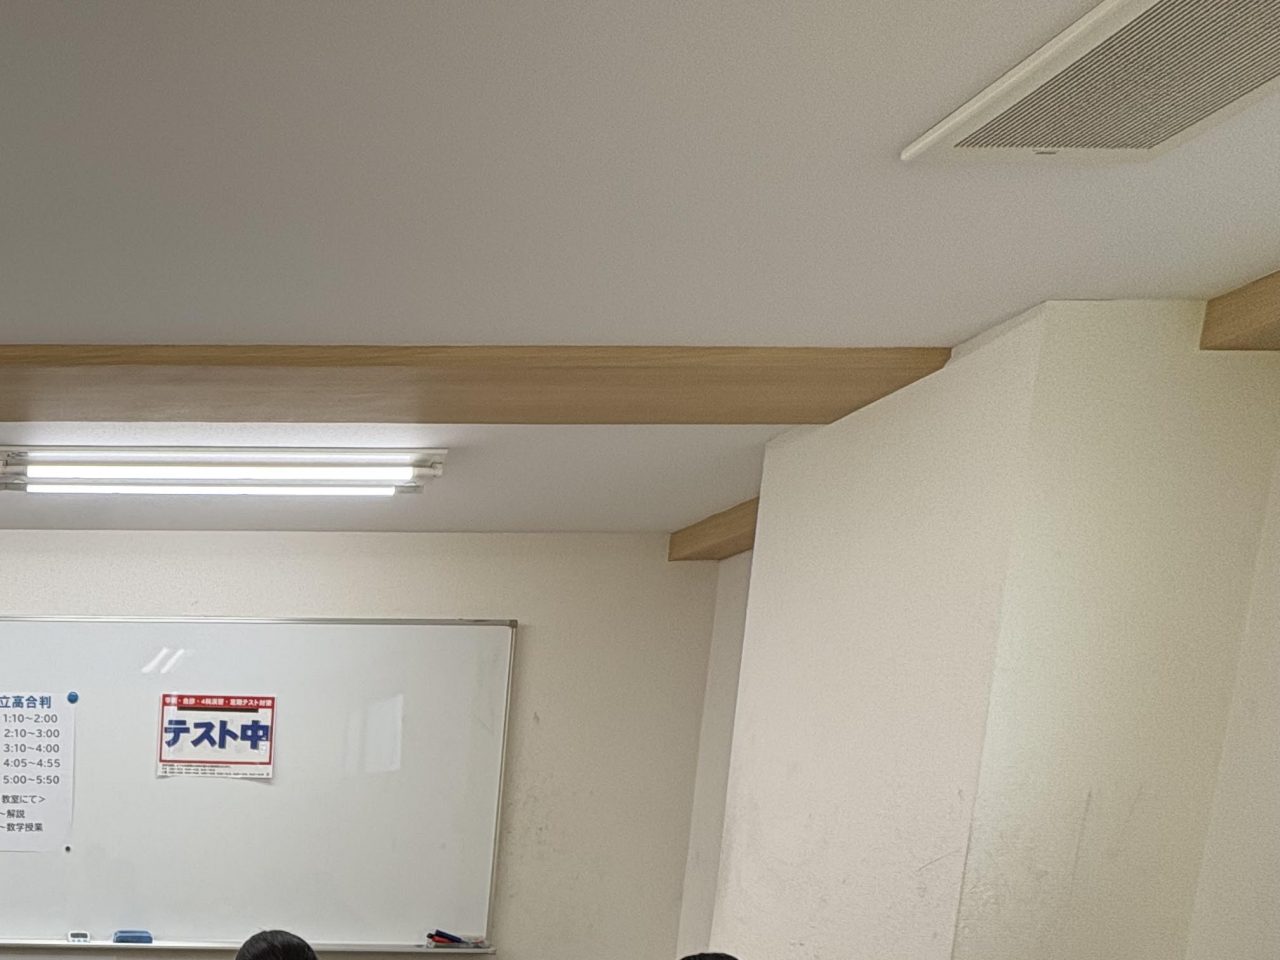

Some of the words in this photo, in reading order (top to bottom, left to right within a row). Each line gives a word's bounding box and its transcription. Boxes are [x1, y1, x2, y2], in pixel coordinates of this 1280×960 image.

[3, 713, 58, 723] 1:10~2:00
[3, 728, 60, 738] 2:10~3:00
[164, 719, 270, 750] テスト中
[3, 743, 60, 753] 3:10~4:00
[3, 758, 61, 768] 4:05~4:55
[2, 775, 60, 785] 5:00~5:50
